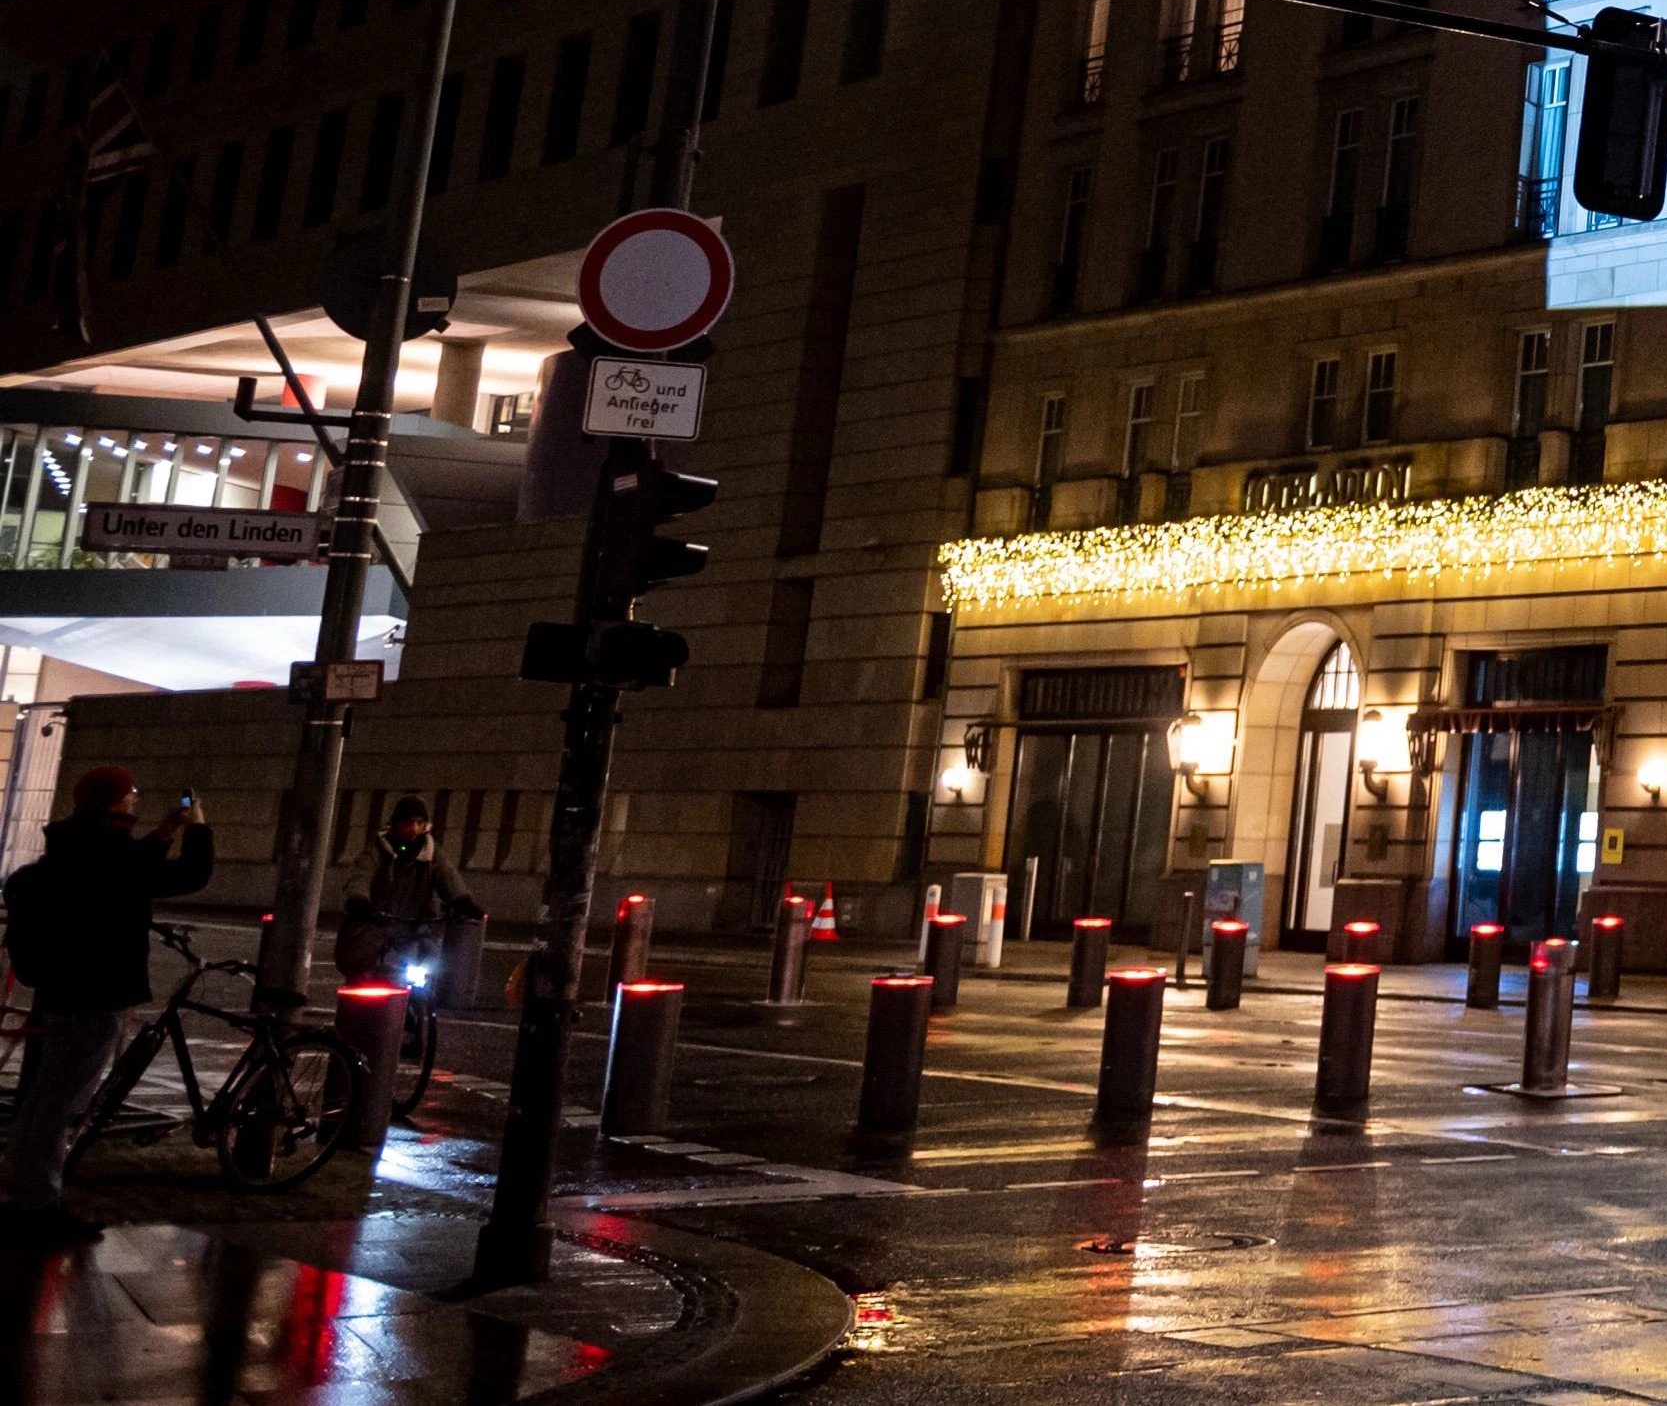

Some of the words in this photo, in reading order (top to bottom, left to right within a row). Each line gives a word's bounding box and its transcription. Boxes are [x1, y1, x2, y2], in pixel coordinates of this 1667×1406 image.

[656, 384, 687, 397] und
[606, 395, 680, 415] Anlieger
[626, 413, 656, 429] frei
[102, 512, 168, 536] Unter
[177, 516, 219, 540] den
[228, 519, 302, 543] Linden
